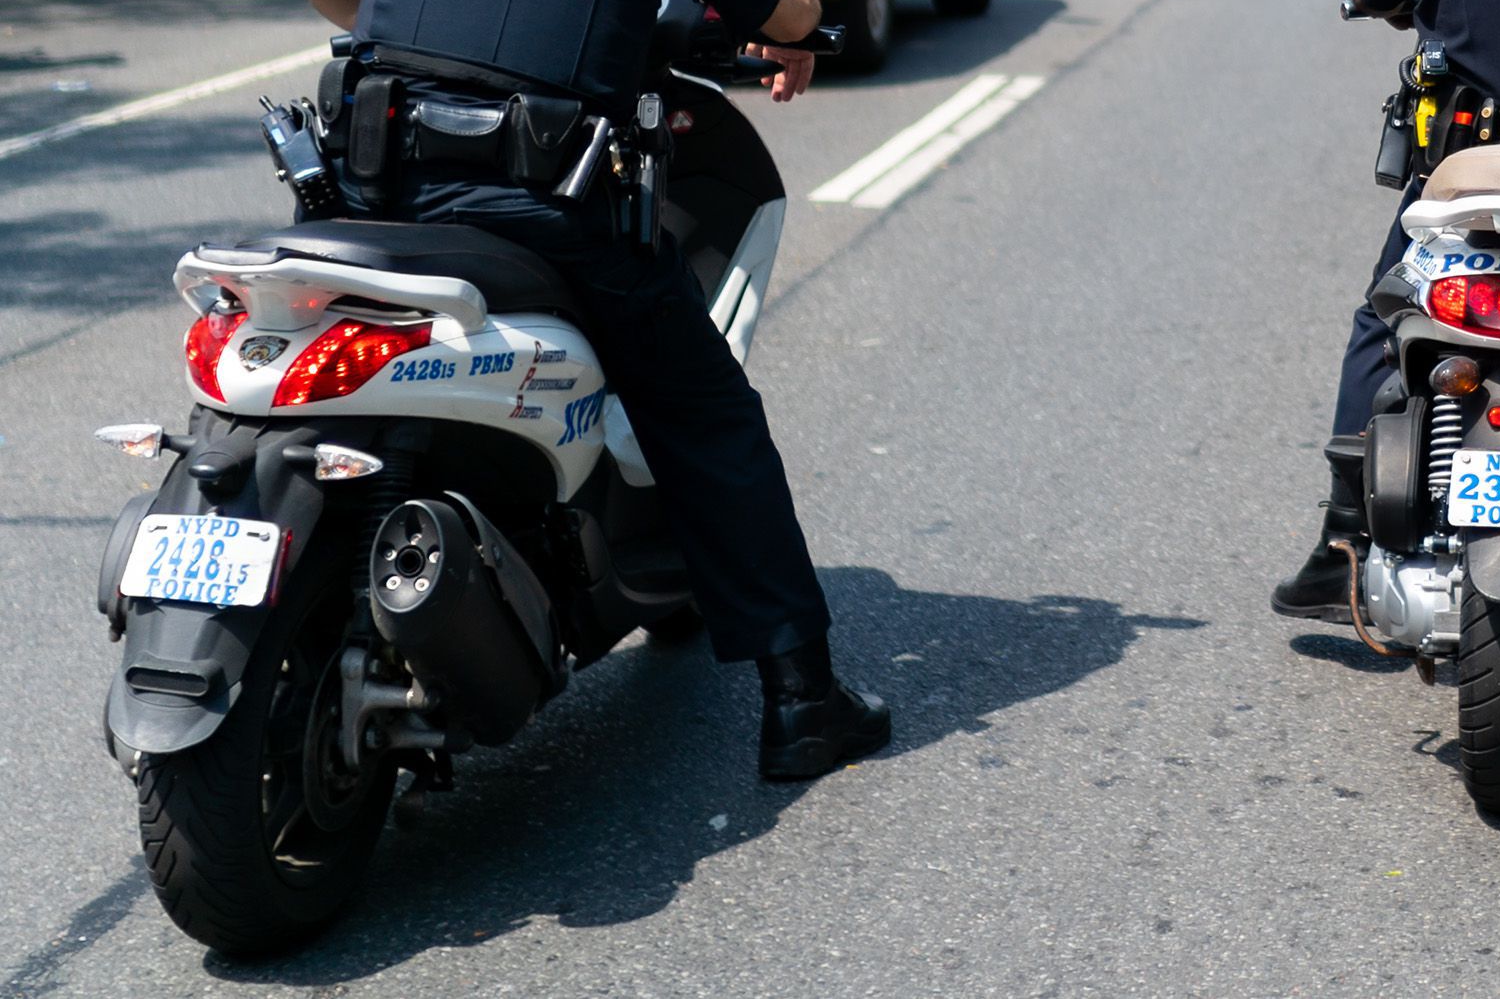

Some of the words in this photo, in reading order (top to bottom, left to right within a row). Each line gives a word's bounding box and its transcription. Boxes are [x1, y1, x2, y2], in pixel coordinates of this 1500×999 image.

[469, 352, 515, 376] PBMS
[176, 518, 240, 538] NYPD
[145, 578, 239, 606] POLICE
